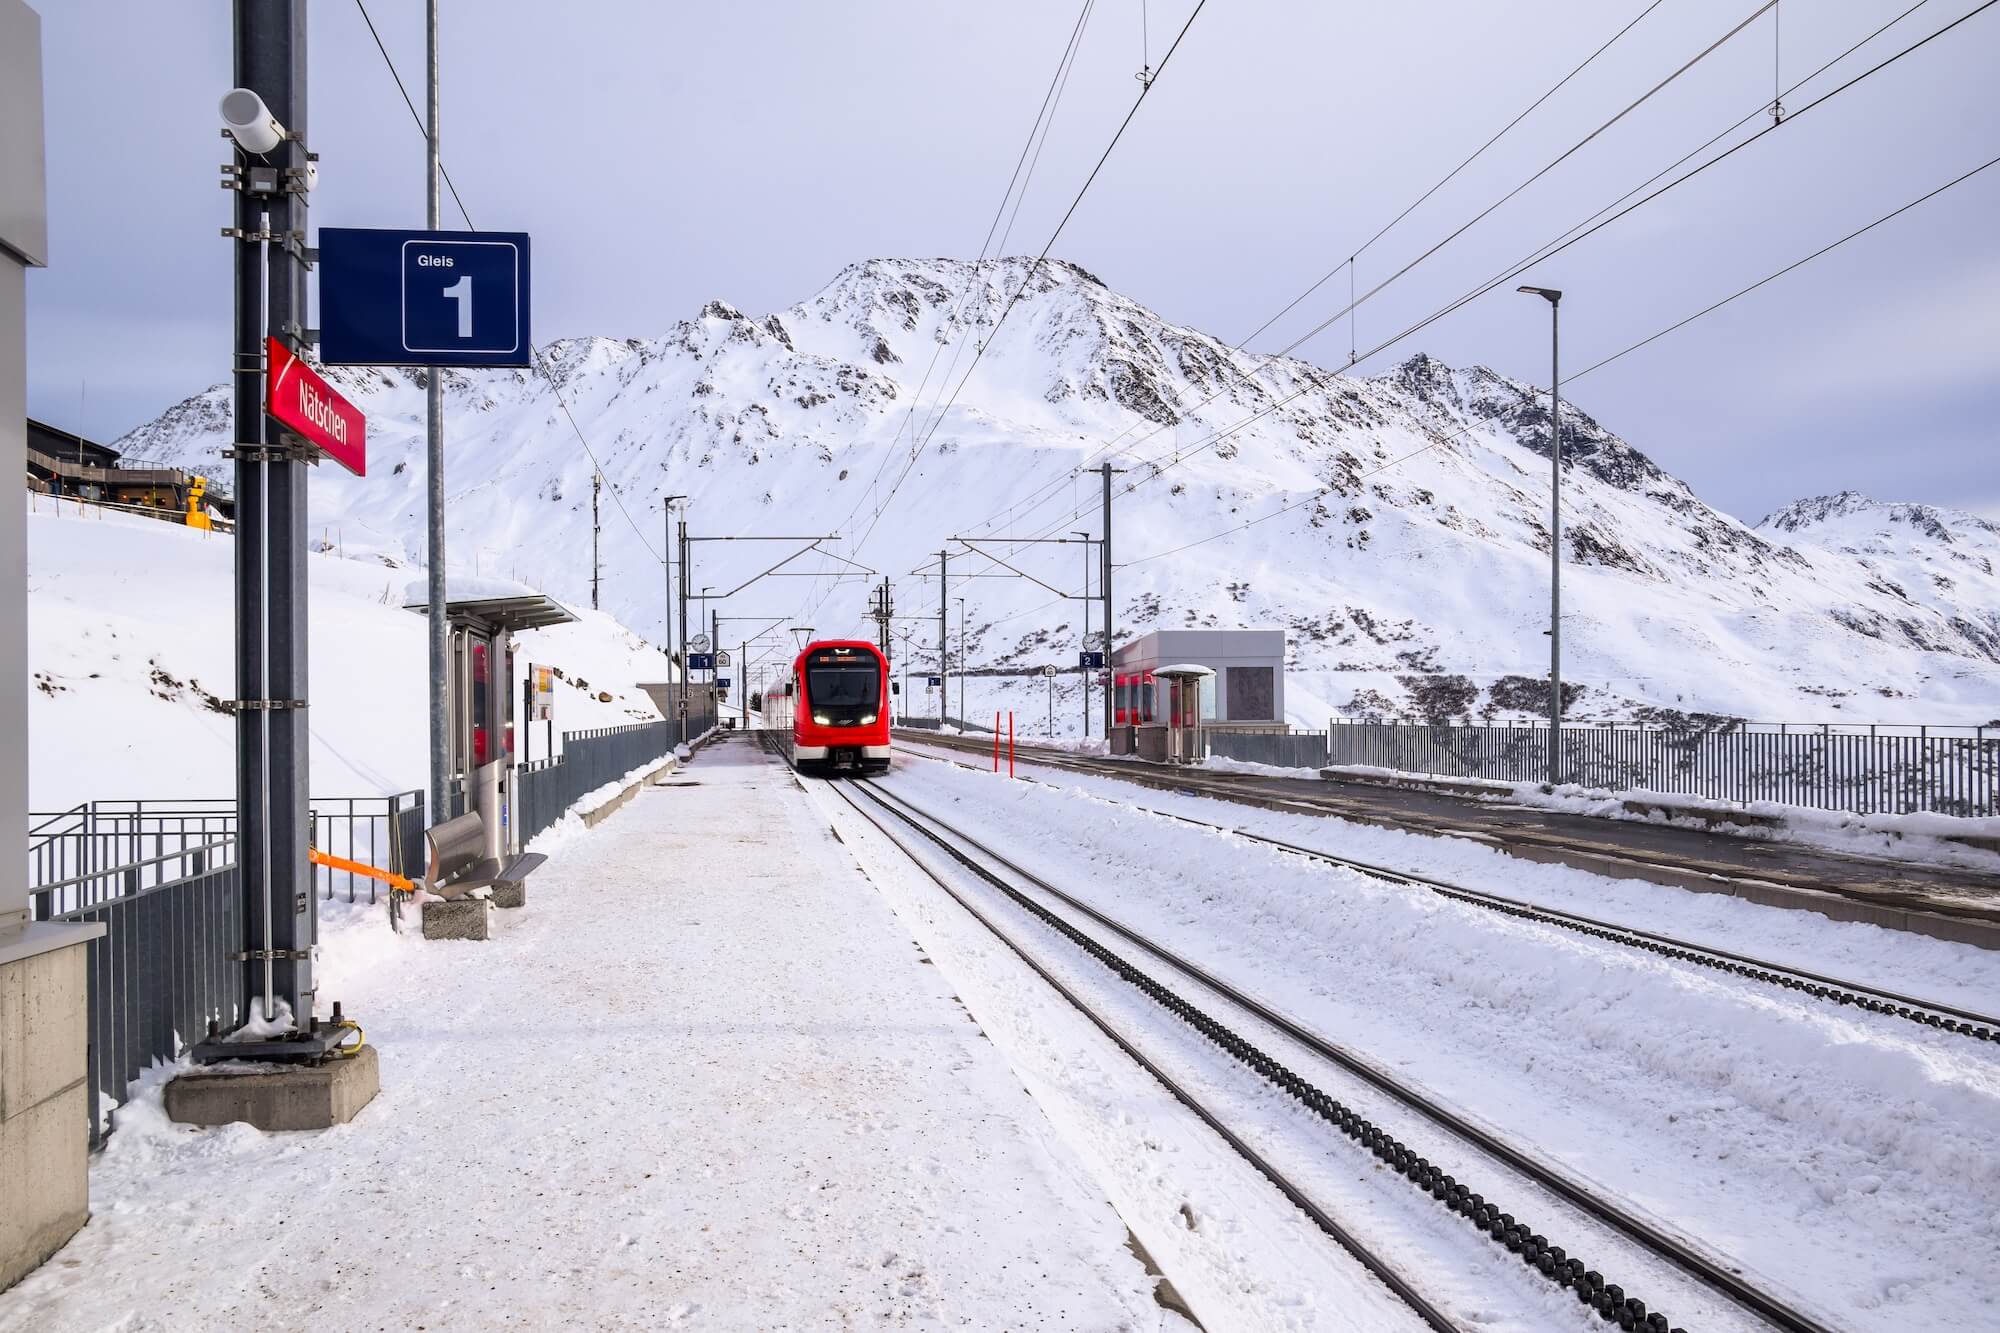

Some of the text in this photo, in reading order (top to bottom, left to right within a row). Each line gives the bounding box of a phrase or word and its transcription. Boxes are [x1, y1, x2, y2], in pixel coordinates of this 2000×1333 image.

[417, 254, 454, 268] Gleis
[443, 275, 473, 338] 1
[299, 378, 347, 446] Nätschen
[1084, 656, 1091, 666] 2
